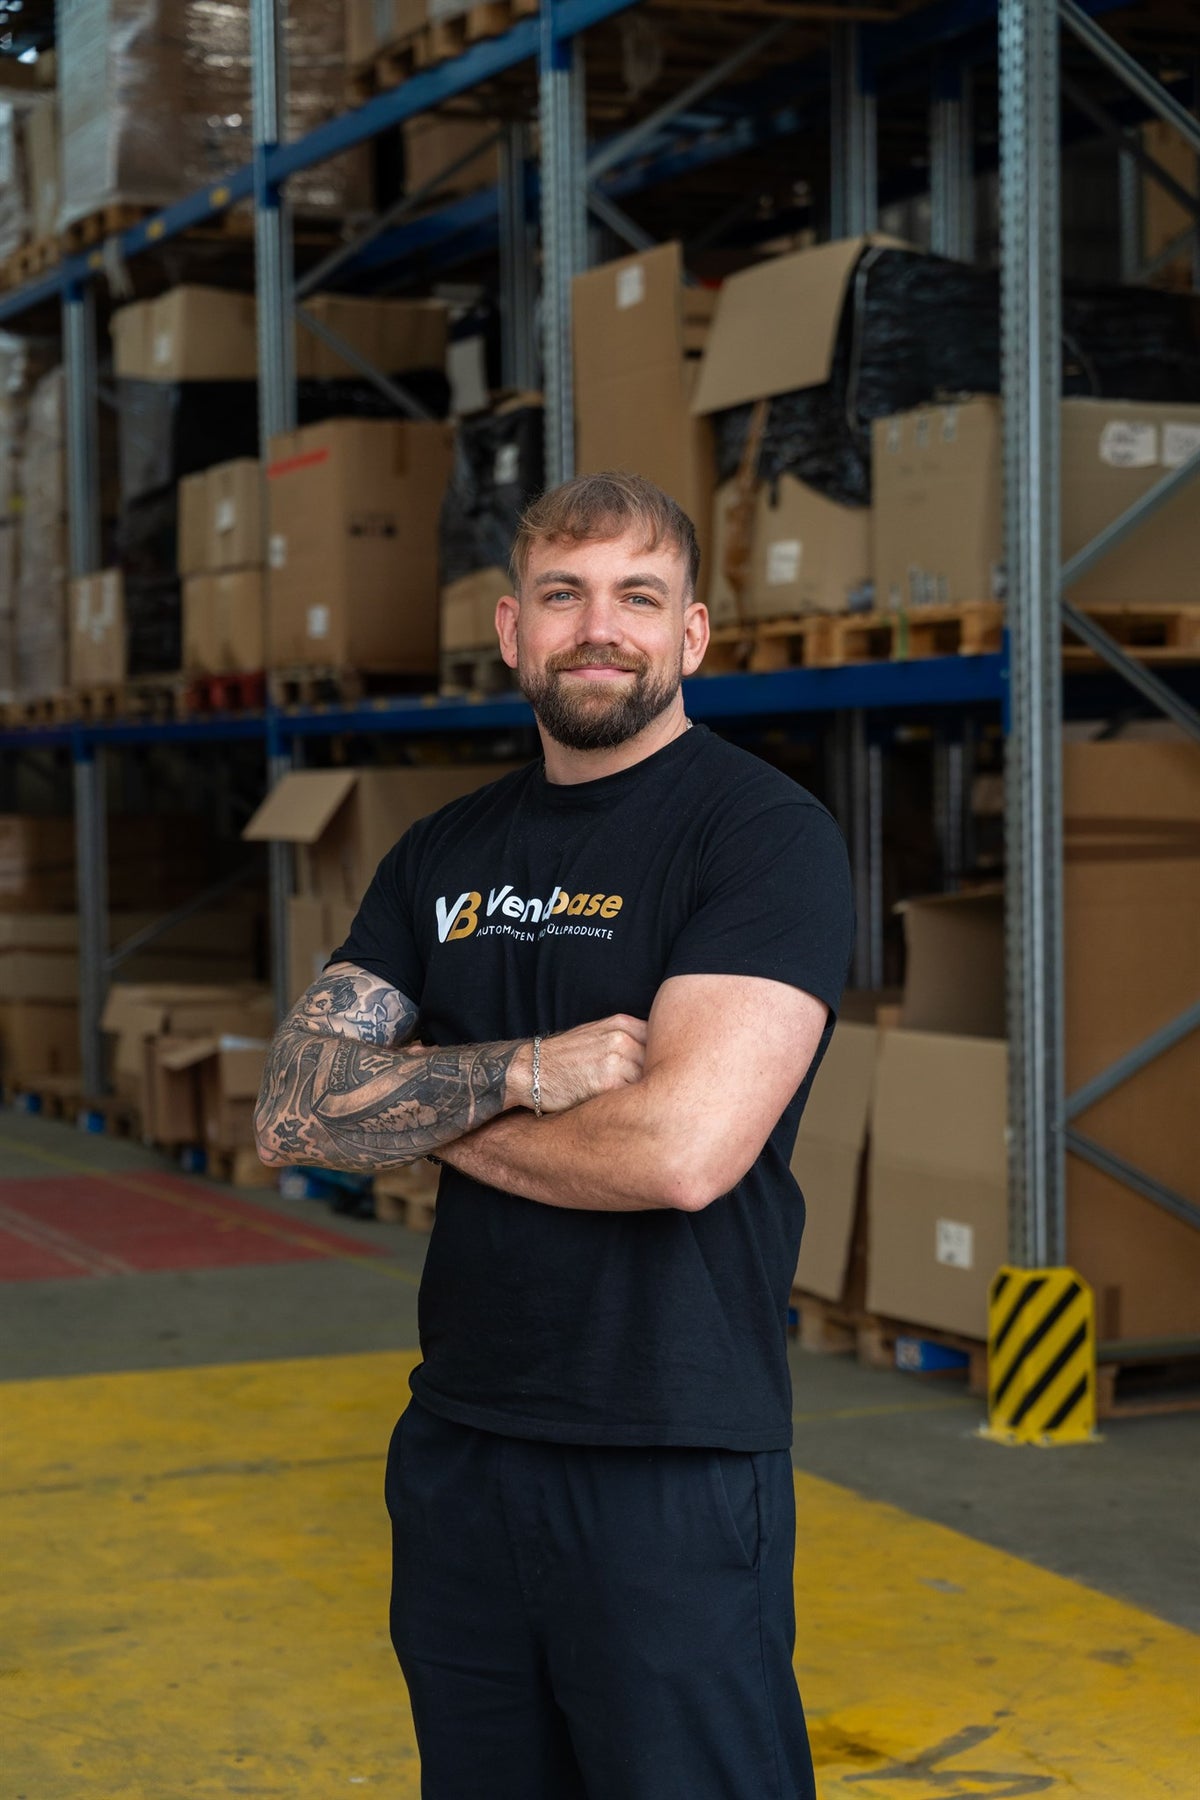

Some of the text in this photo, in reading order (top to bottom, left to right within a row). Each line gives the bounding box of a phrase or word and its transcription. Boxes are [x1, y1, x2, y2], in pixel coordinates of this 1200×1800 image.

[435, 885, 624, 944] VB Vendbase
[476, 925, 535, 942] AUTOMATEN
[546, 923, 614, 940] ÜLLPRODUKTE
